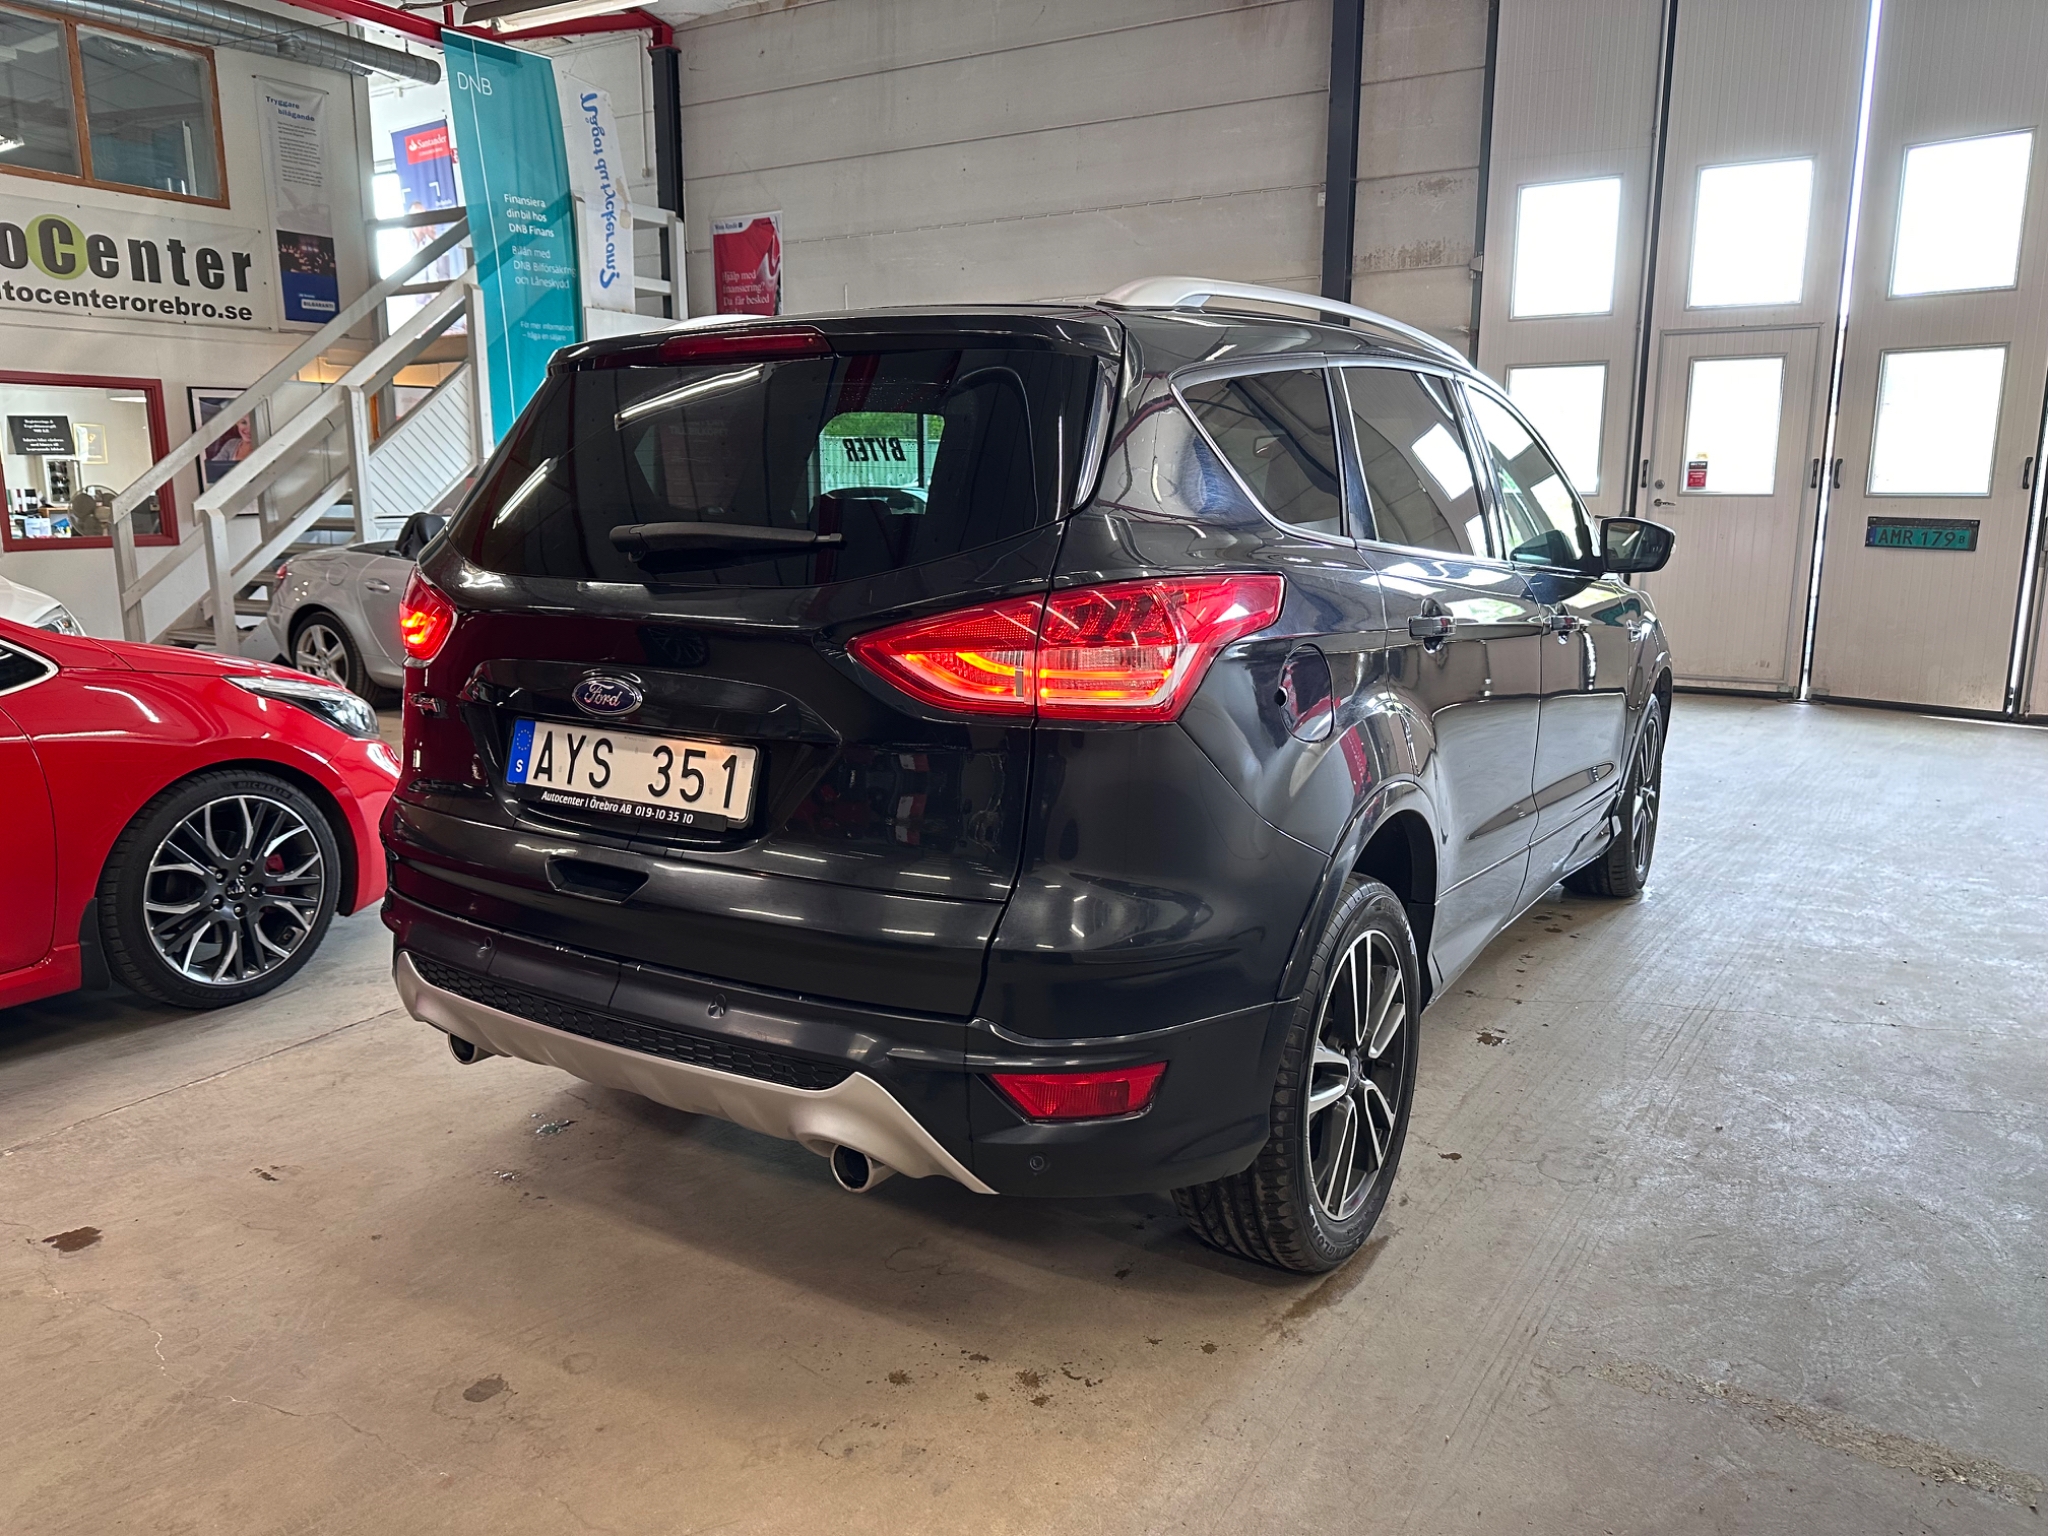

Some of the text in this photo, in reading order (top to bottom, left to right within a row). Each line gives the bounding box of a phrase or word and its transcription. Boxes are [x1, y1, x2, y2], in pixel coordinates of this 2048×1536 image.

[457, 71, 493, 96] DNB
[265, 95, 300, 110] Tryggare
[417, 133, 447, 149] Santander
[503, 193, 546, 208] Finansiera
[506, 208, 547, 222] din bil hos
[508, 223, 555, 238] DNB Finans
[533, 249, 551, 259] med
[513, 260, 532, 271] DNB
[740, 269, 757, 280] med
[515, 275, 570, 290] och Låneskydd
[0, 279, 253, 321] tocenterorebro.se
[723, 296, 733, 306] Du
[745, 293, 770, 306] besked
[1877, 528, 1966, 547] AMR 179 B
[583, 681, 623, 707] Ford
[515, 759, 524, 773] S
[532, 730, 738, 809] AYS 351
[540, 790, 584, 807] Autocenter
[589, 795, 619, 813] Örebro
[619, 803, 632, 815] AB
[634, 805, 666, 820] 019-10
[666, 810, 680, 822] 35
[682, 812, 694, 824] 10
